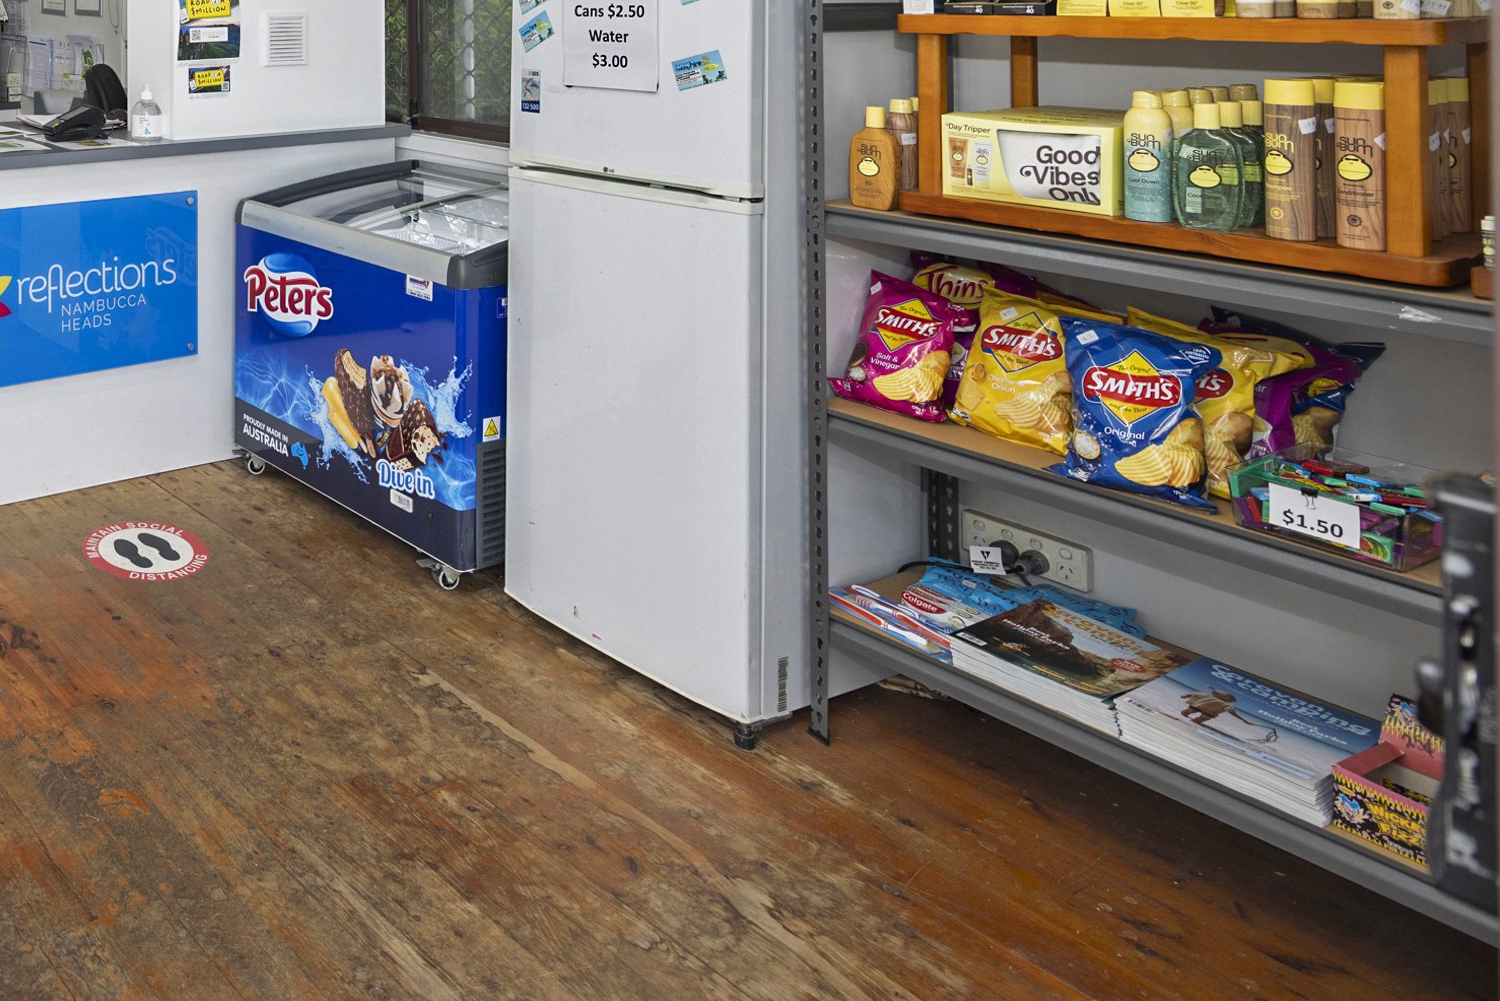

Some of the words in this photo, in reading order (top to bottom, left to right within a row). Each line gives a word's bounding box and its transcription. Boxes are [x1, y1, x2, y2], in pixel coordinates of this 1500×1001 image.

[191, 6, 226, 17] $MILLION
[574, 4, 604, 18] Cans
[608, 3, 645, 19] $2.50
[589, 29, 629, 43] Water
[592, 52, 628, 68] $3.00
[197, 71, 211, 79] ROAD
[945, 123, 963, 132] Day
[963, 124, 991, 134] Tripper
[1036, 145, 1100, 165] Good
[1020, 165, 1100, 186] Vibes
[16, 256, 177, 313] reflections
[244, 266, 333, 318] Peters
[916, 266, 989, 301] Thins
[62, 293, 147, 317] NAMBUCCA
[62, 314, 112, 333] HEADS
[875, 308, 941, 337] SMITH'S
[984, 328, 1056, 358] SMITH'S
[870, 357, 900, 370] Vinegar
[876, 352, 892, 361] Salt
[1116, 364, 1128, 372] The
[1129, 365, 1152, 374] Original
[991, 382, 1016, 393] Onion
[1087, 370, 1174, 401] SMITH'S
[243, 413, 266, 431] PROUDLY
[266, 425, 281, 440] MADE
[281, 434, 288, 443] IN
[1104, 426, 1145, 441] Original
[243, 422, 289, 457] AUSTRALIA
[376, 459, 414, 494] Dive
[414, 468, 435, 499] in
[1282, 509, 1344, 538] $1.50
[85, 524, 122, 558] MAINTAIN
[126, 522, 183, 537] SOCIAL
[129, 554, 208, 580] DISTANCING
[903, 592, 938, 613] Colgate
[1369, 802, 1428, 838] WICKE
